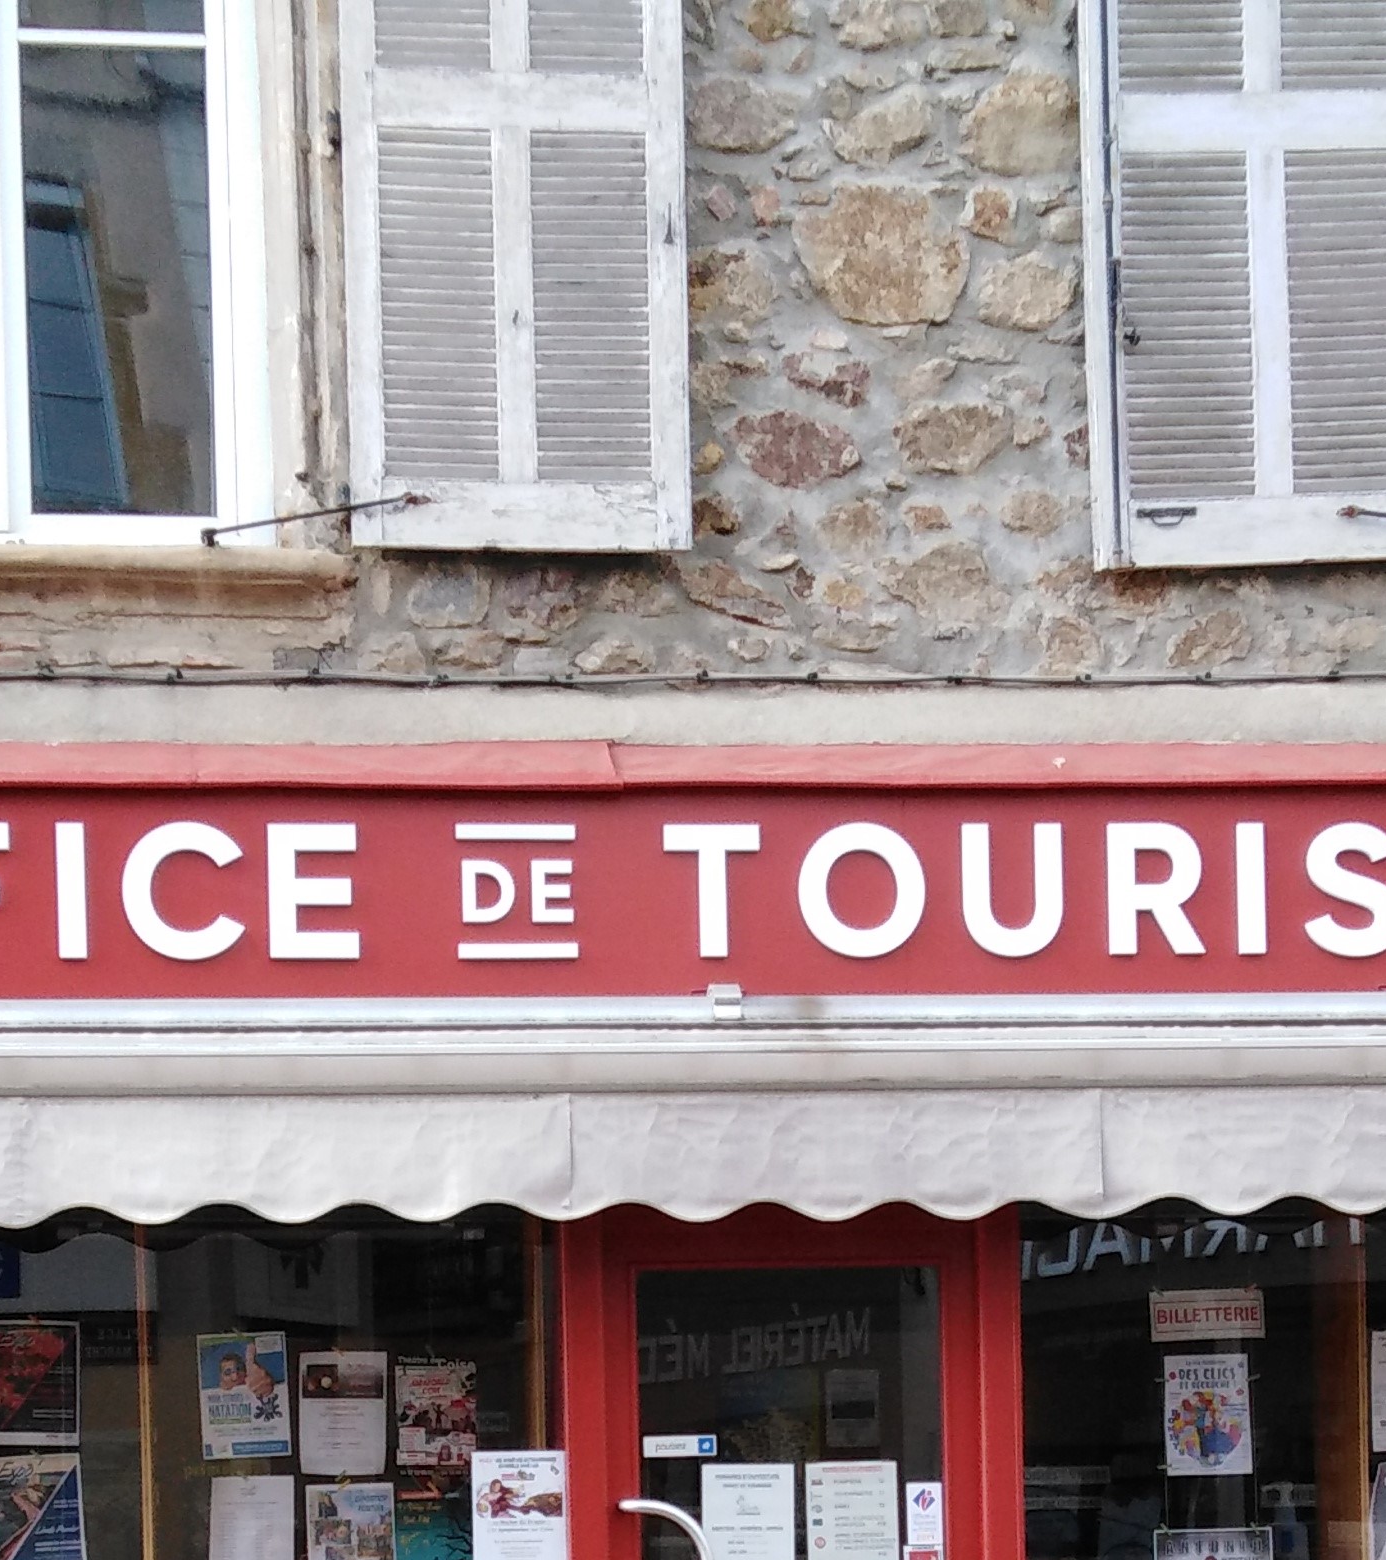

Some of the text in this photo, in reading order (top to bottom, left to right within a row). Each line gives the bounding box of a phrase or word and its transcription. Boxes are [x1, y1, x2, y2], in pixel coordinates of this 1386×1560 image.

[459, 859, 575, 924] DE
[1156, 1306, 1260, 1325] BILLETTERIE
[1178, 1369, 1199, 1381] DES
